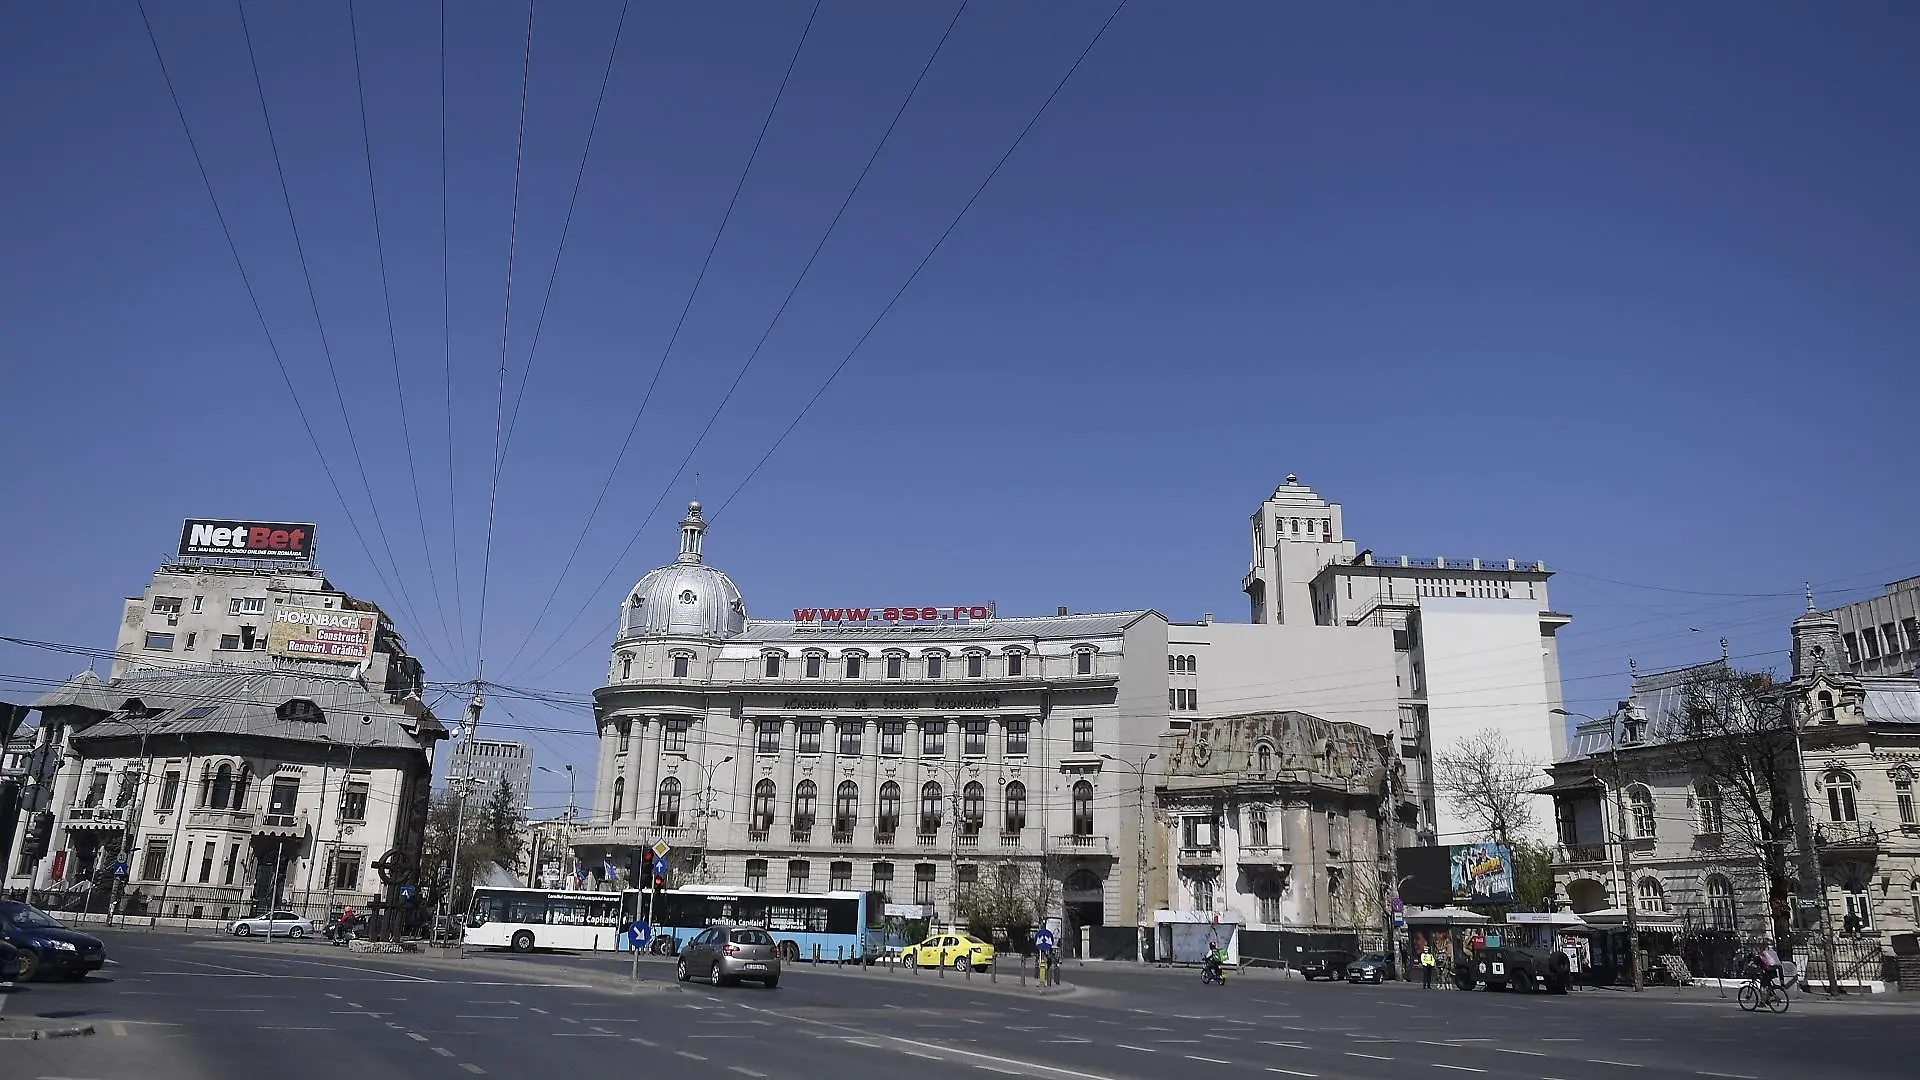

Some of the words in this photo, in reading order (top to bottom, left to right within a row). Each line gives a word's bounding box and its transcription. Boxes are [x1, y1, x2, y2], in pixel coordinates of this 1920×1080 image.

[189, 524, 305, 549] NetBet
[276, 610, 359, 629] HORNBACH
[793, 606, 987, 622] www.ase.ro
[289, 640, 328, 654] Renovări.
[331, 644, 365, 657] Grădină.
[784, 699, 839, 709] ACADEMIA
